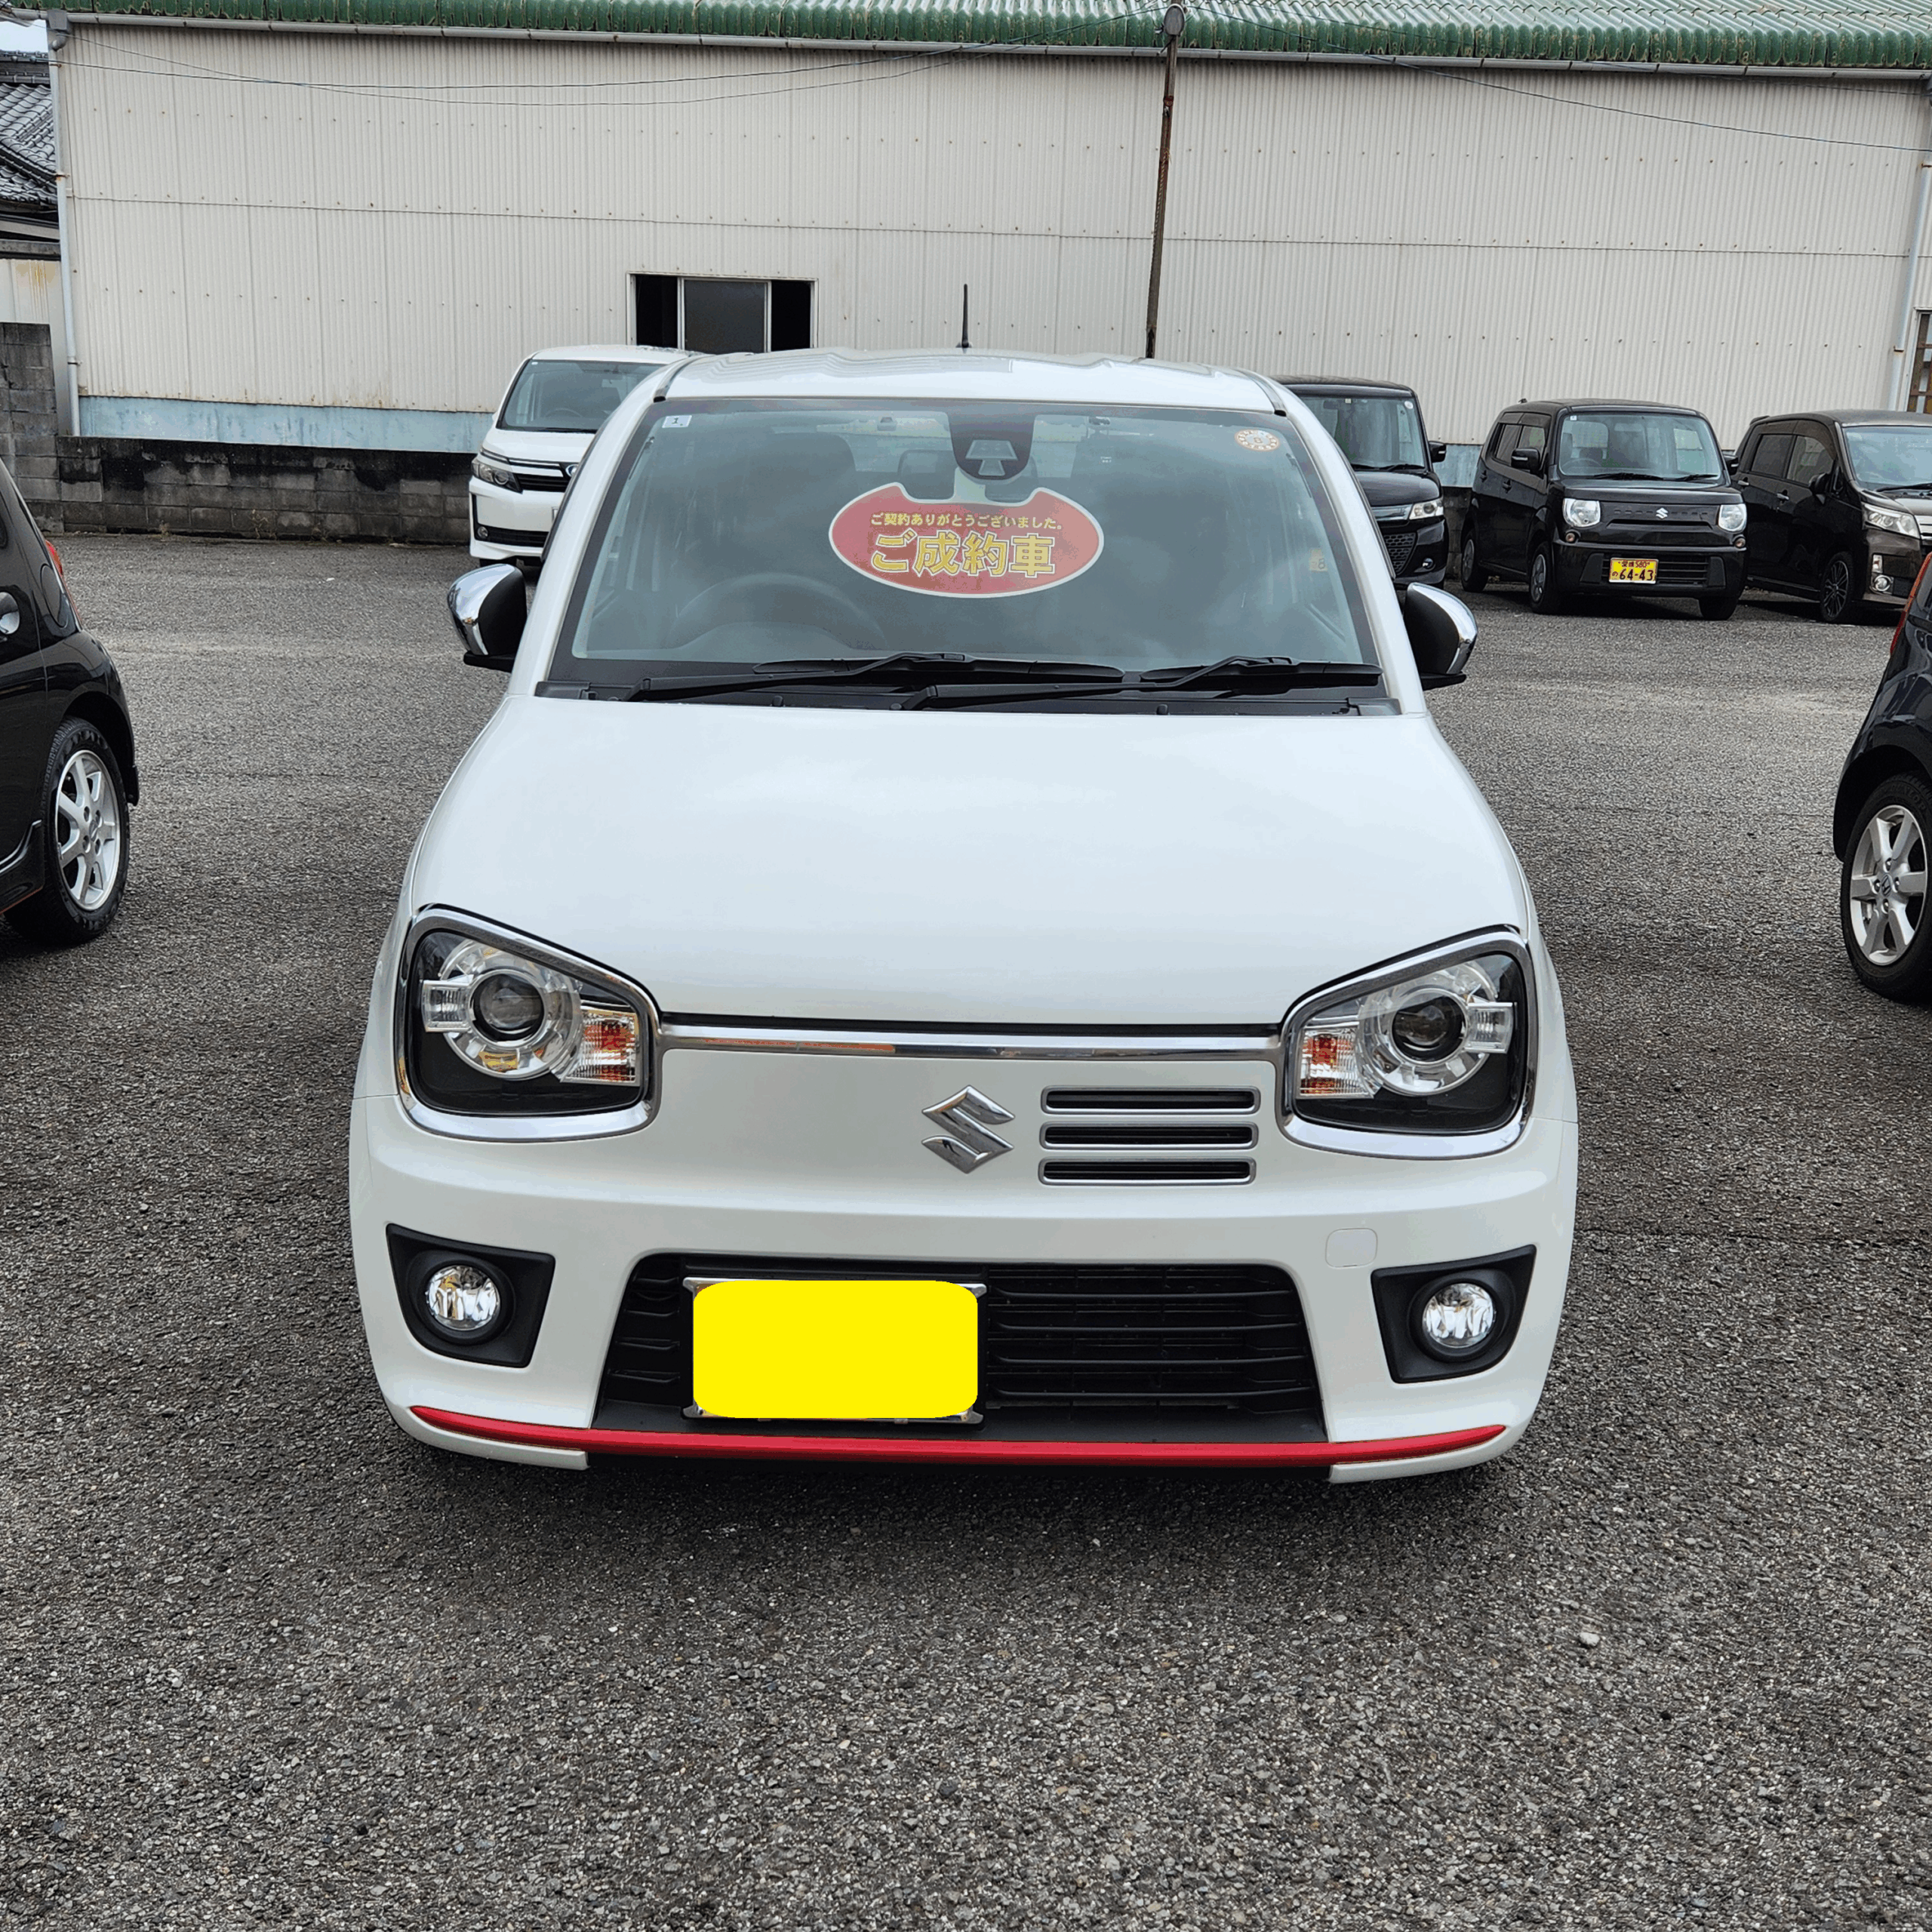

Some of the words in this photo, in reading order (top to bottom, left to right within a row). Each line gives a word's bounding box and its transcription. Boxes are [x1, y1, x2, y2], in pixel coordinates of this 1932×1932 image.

[871, 512, 1063, 530] ご契約ありがとうございました。
[871, 528, 1056, 578] ご成約車
[1620, 568, 1654, 580] 64-43
